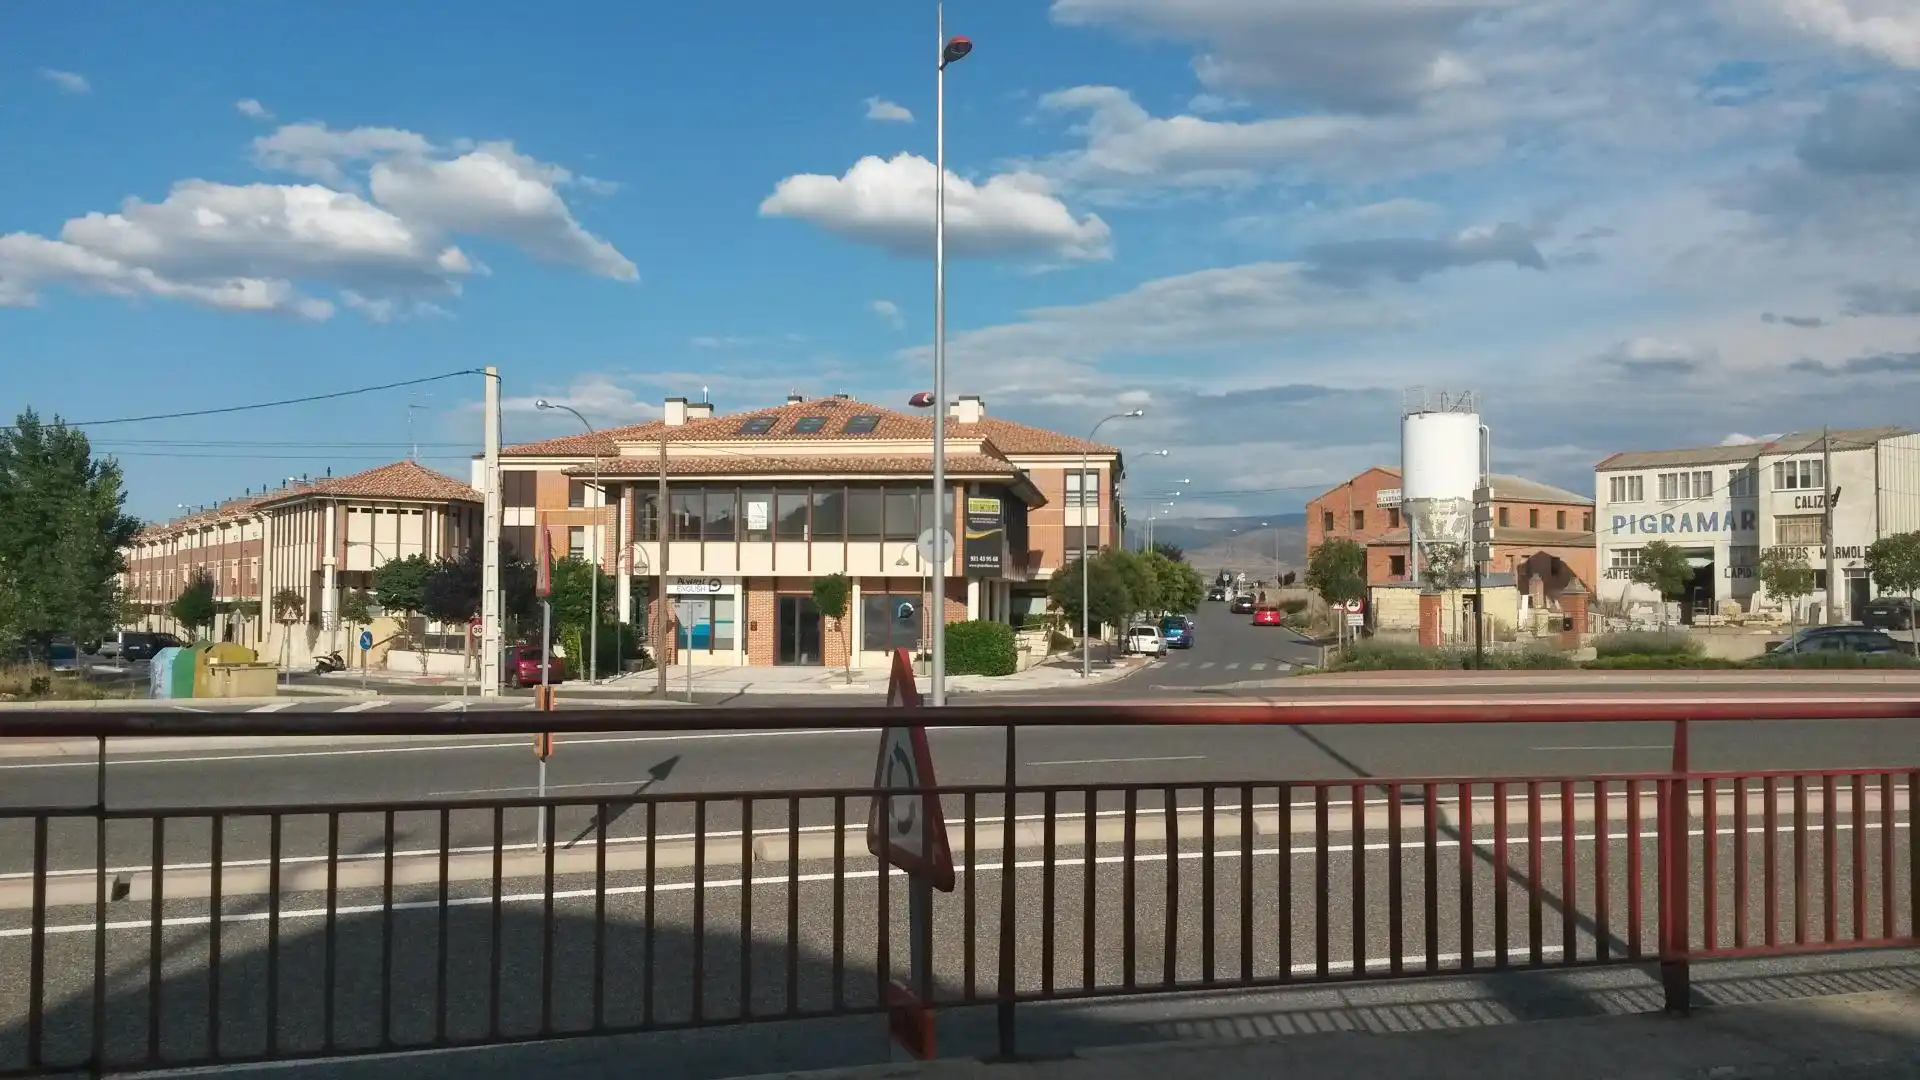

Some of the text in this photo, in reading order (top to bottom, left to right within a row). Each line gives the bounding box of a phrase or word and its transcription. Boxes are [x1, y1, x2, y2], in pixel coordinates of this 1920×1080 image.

[1795, 495, 1837, 509] CALIZS
[1612, 509, 1756, 535] PIGRAMAR
[1820, 546, 1871, 559] MRMOLE
[1724, 567, 1756, 578] LAPID
[676, 585, 706, 593] ENGLISH
